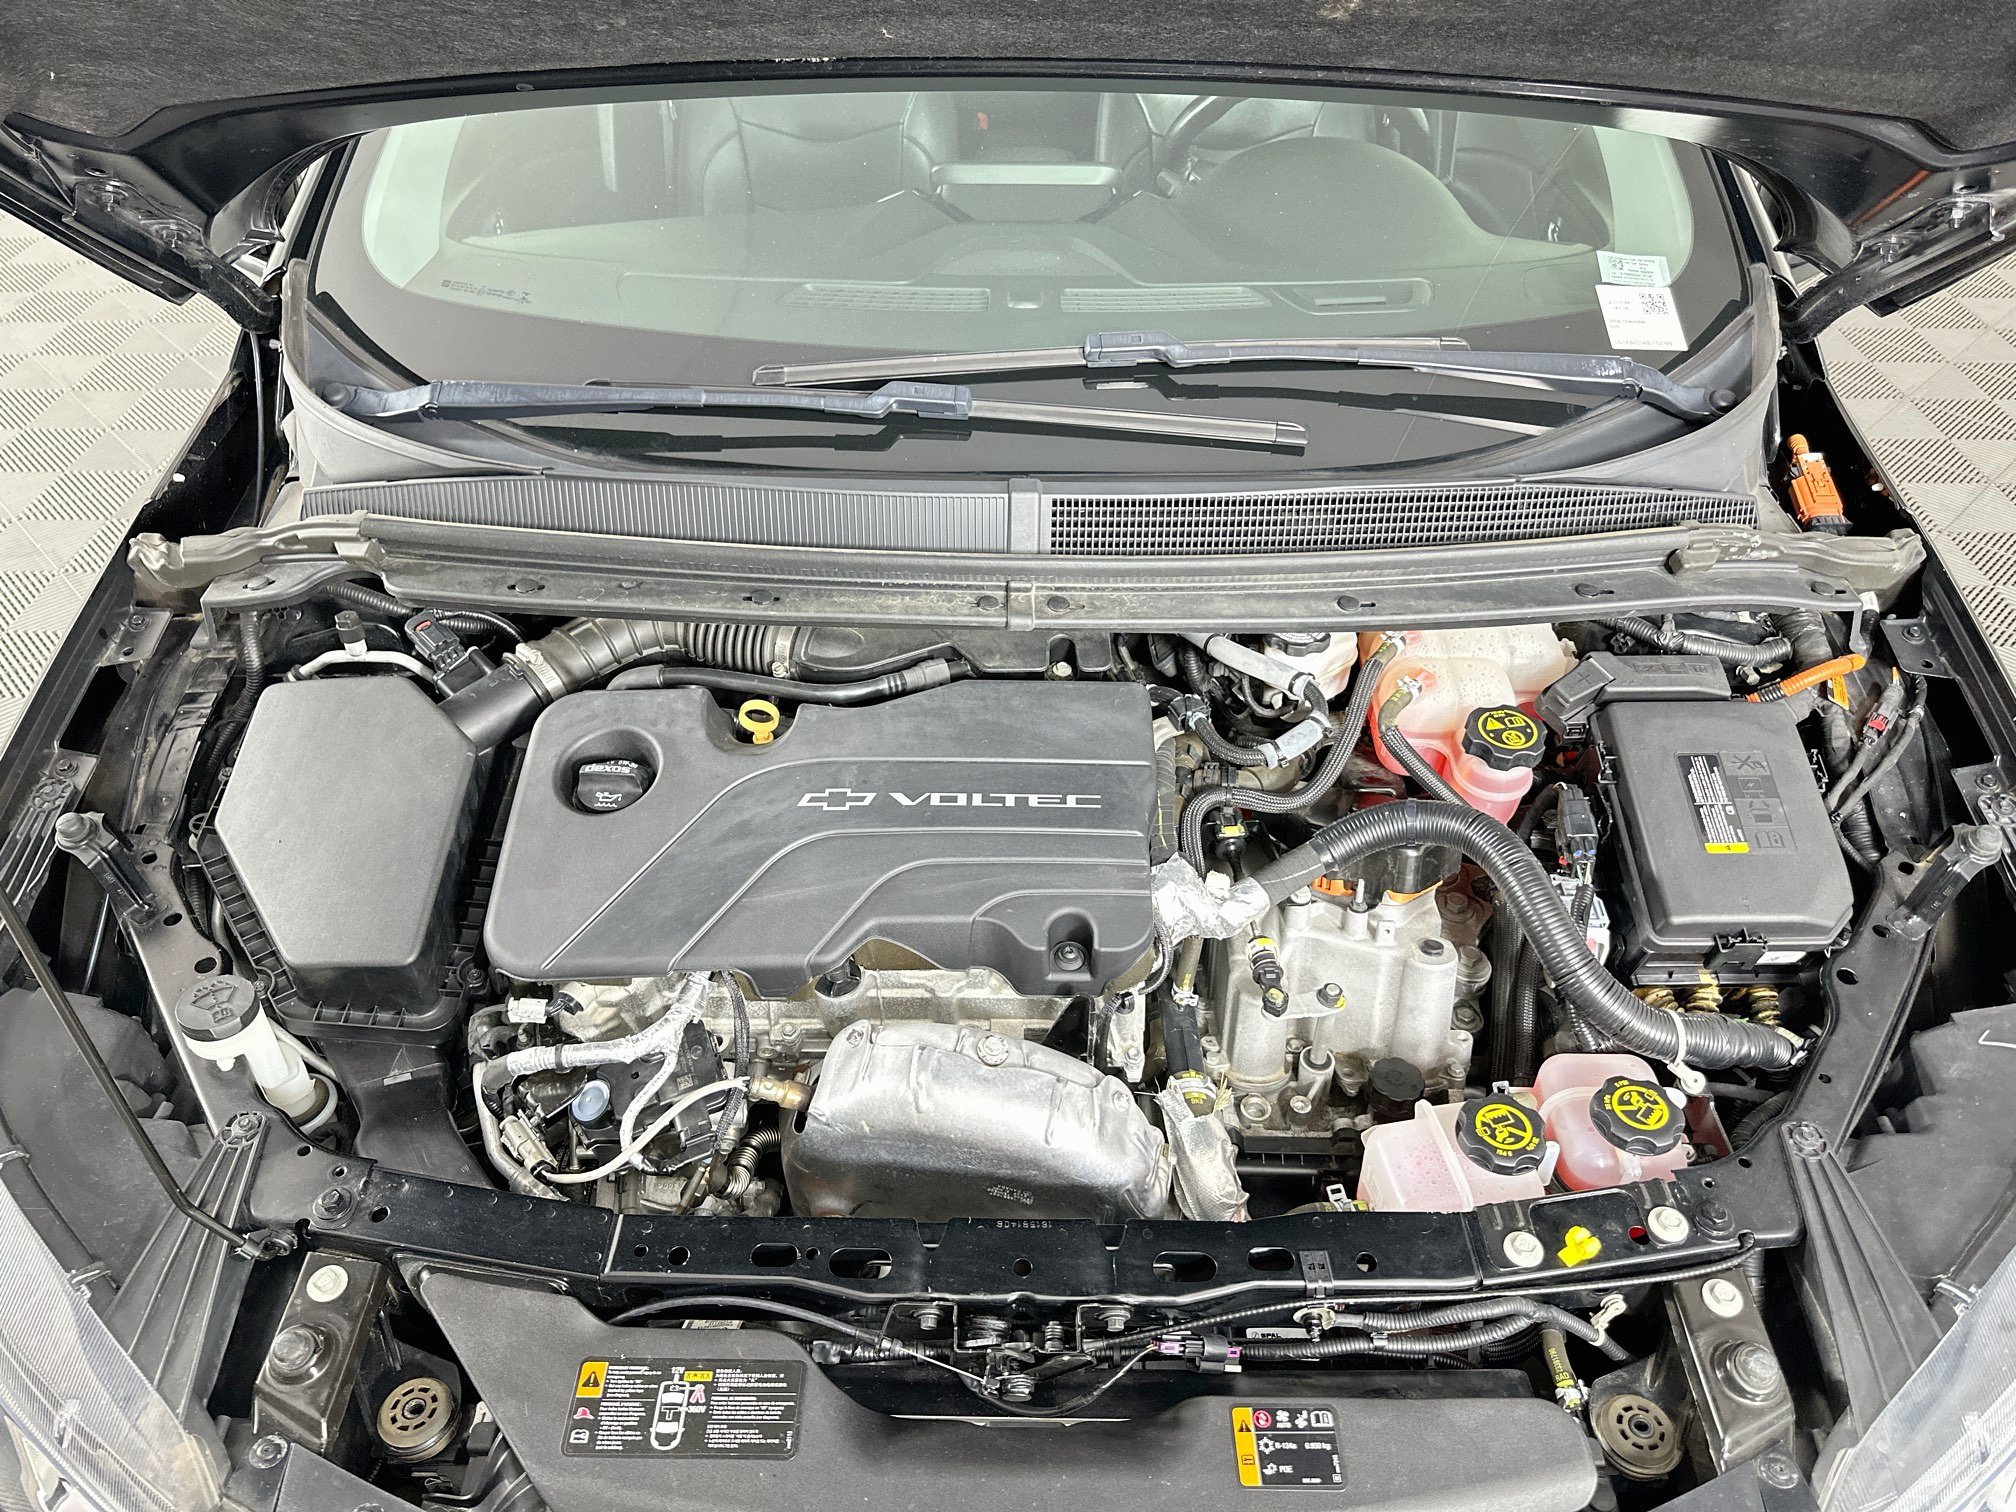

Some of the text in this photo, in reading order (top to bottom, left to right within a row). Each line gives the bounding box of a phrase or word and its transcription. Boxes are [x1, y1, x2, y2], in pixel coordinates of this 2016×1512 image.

[585, 763, 632, 774] dexos
[888, 792, 1102, 808] VOLTEC
[671, 1366, 686, 1374] 12V
[1554, 1371, 1570, 1383] RAD
